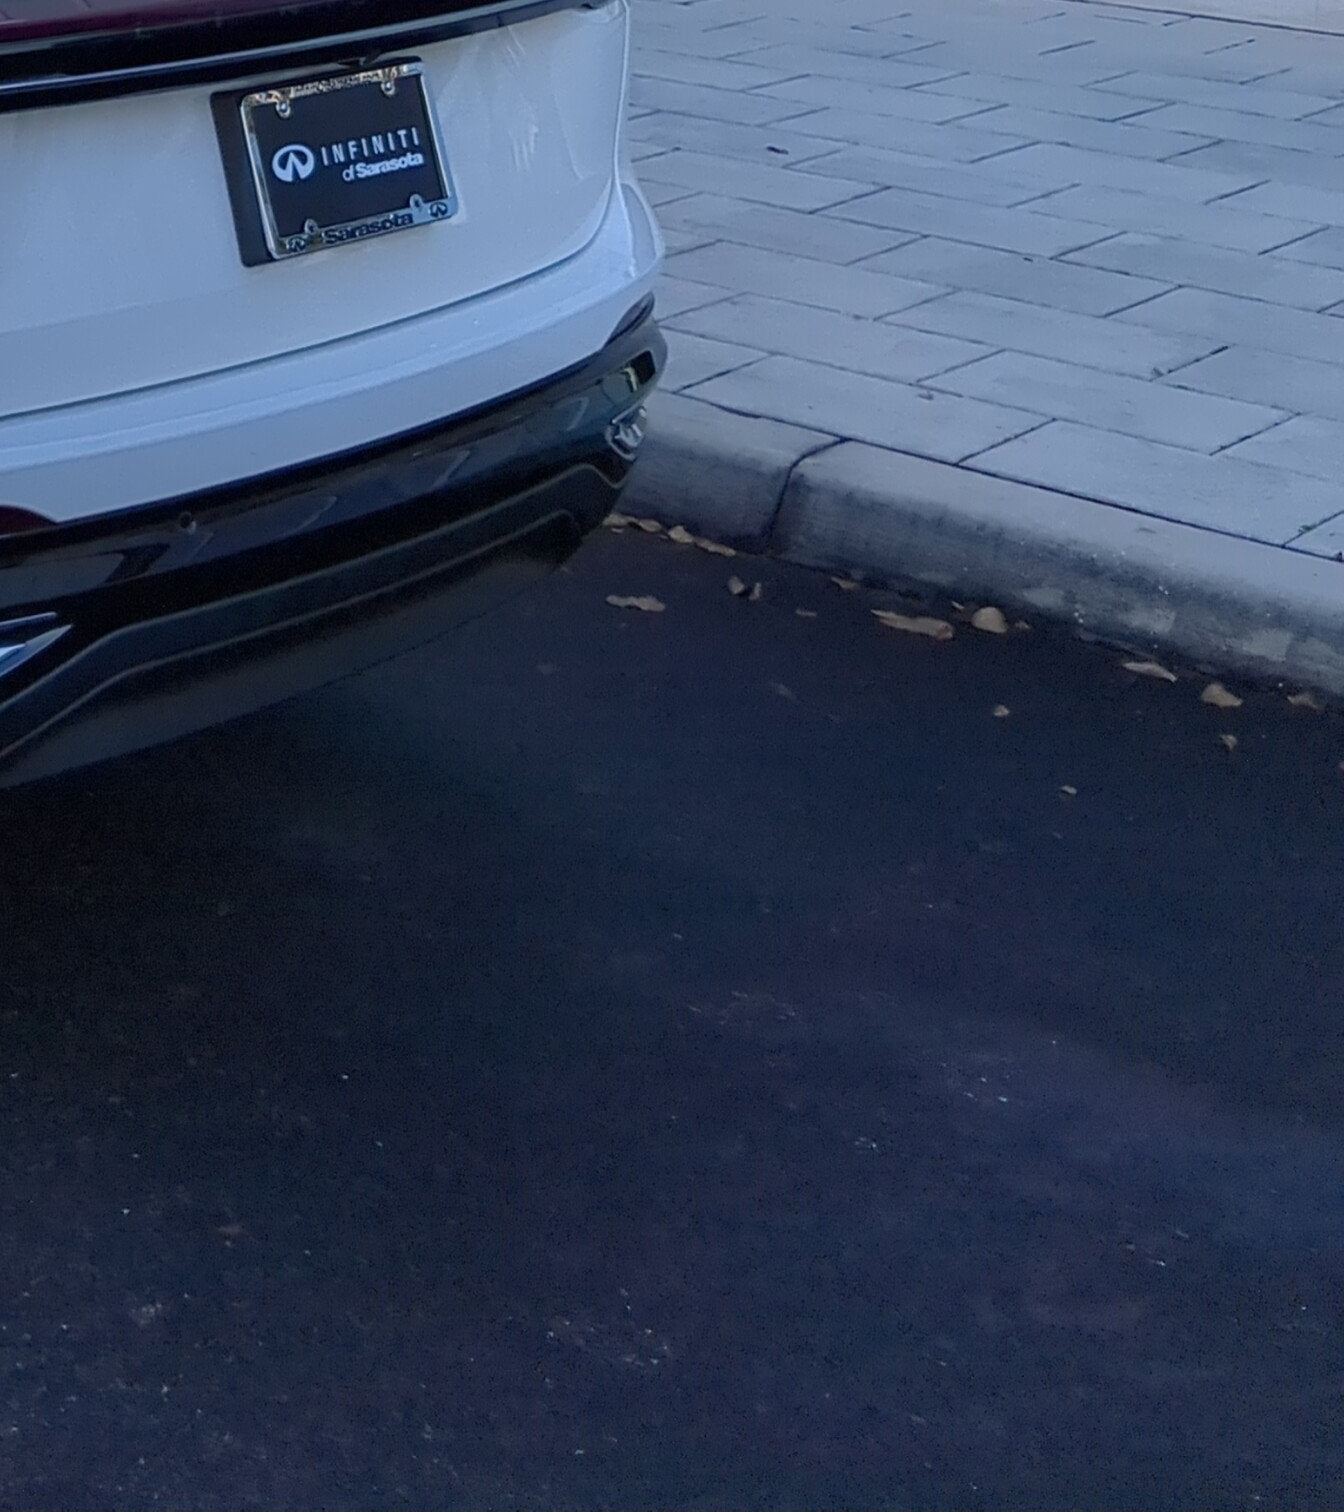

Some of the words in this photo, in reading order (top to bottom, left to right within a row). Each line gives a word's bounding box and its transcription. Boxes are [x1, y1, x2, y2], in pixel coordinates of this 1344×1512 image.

[321, 126, 420, 166] INFINITI
[355, 151, 424, 179] Sarasota
[322, 212, 414, 245] Sarasota
